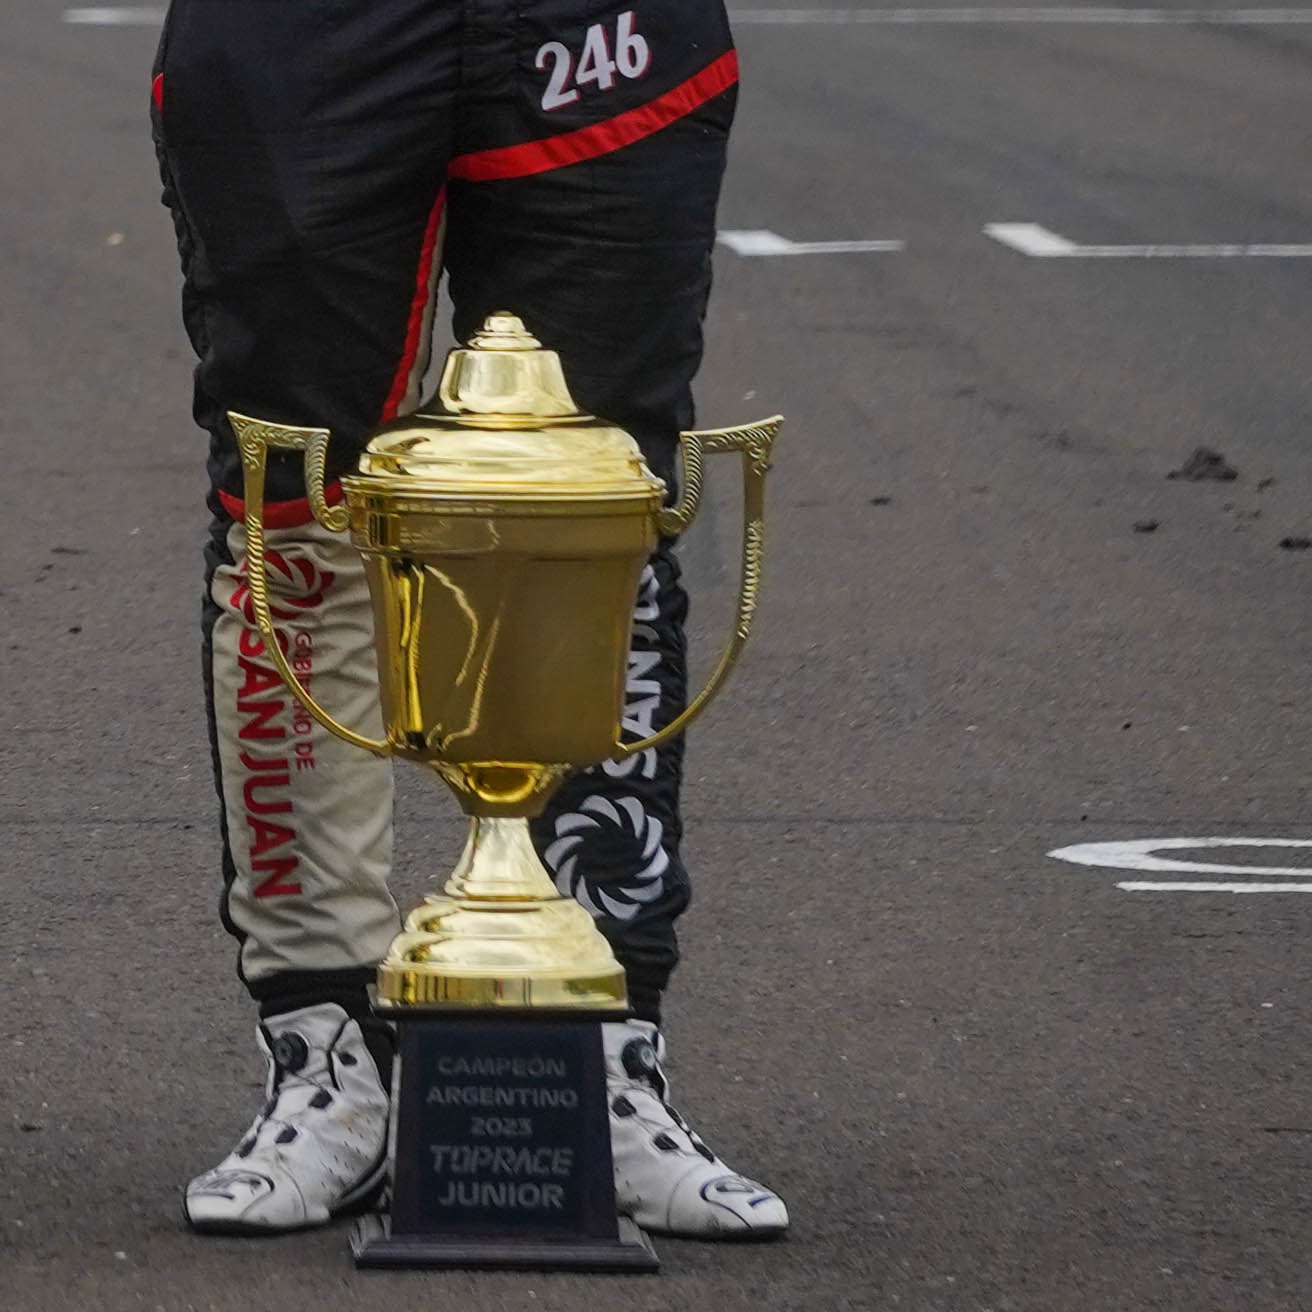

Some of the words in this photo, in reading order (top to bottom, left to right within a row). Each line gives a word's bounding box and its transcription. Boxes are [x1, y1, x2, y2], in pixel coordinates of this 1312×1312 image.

[535, 10, 652, 112] 246
[295, 742, 315, 771] DE
[239, 752, 302, 898] JUAN
[425, 1087, 579, 1108] ARGENTINO
[471, 1117, 533, 1137] 2023
[430, 1145, 574, 1176] TOPRACE
[438, 1183, 565, 1208] JUNIOR
